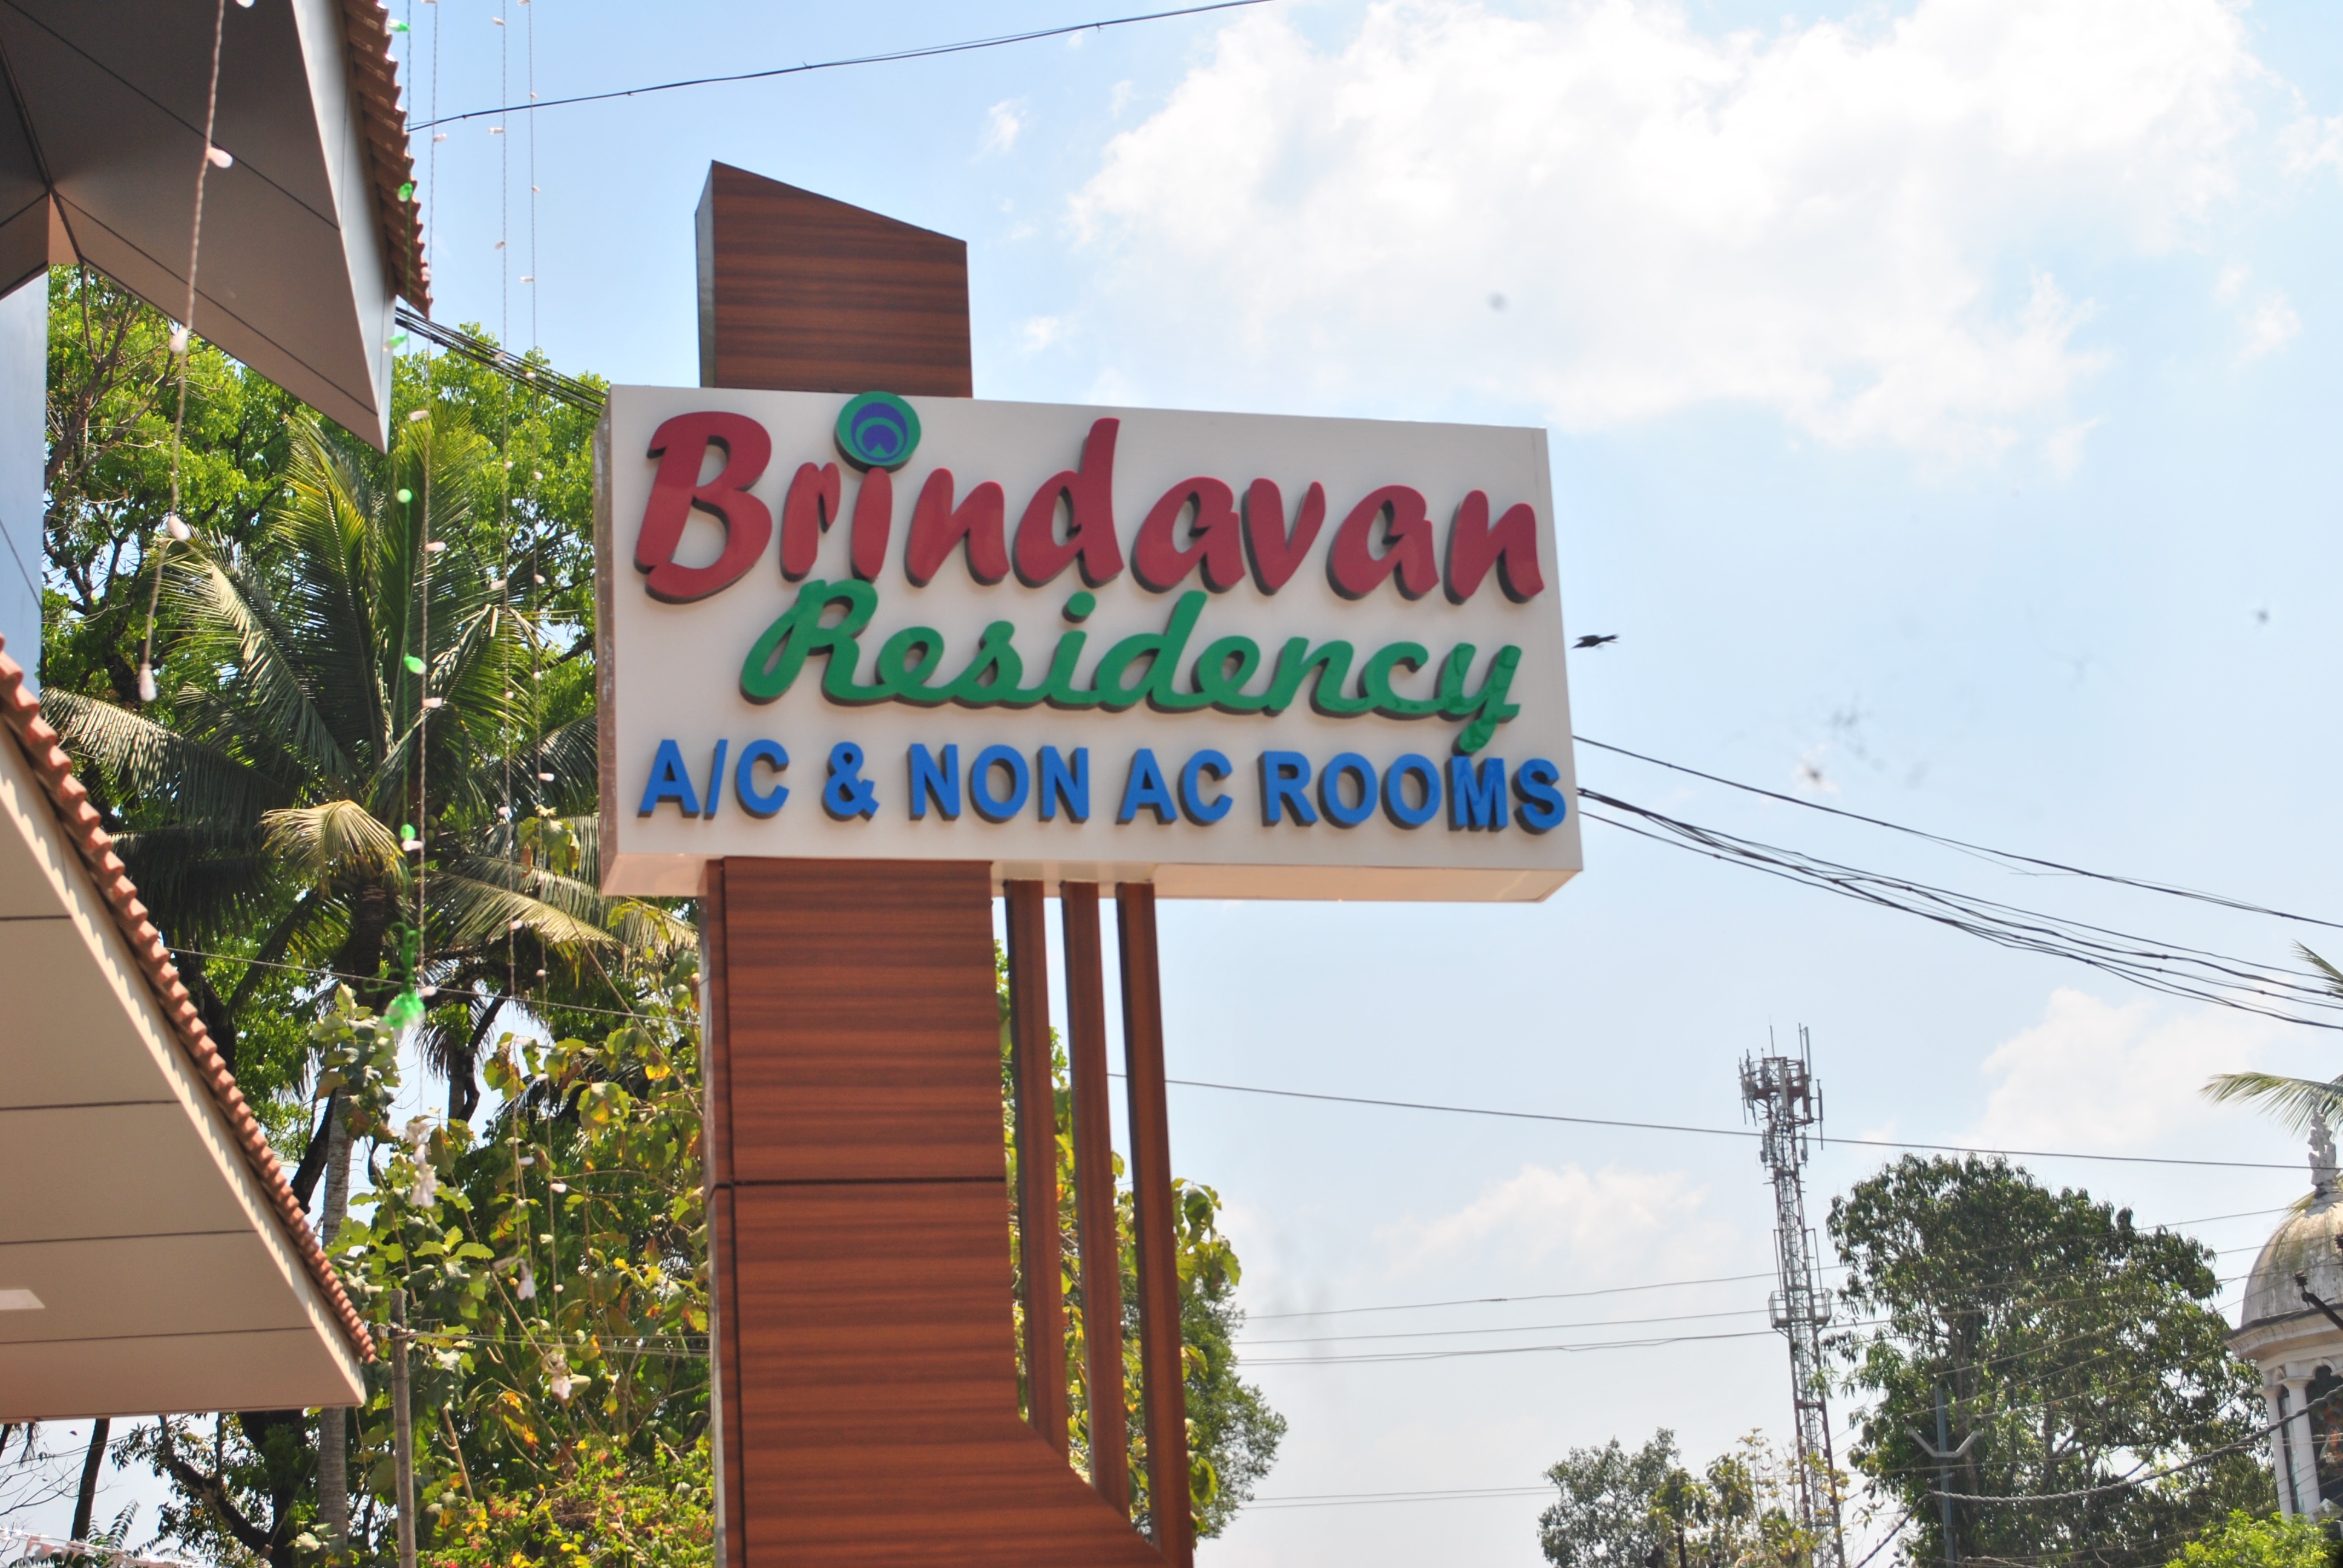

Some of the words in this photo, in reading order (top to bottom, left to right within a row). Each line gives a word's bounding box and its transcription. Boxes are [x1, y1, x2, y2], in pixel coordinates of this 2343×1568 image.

[635, 391, 1545, 604] Brindavan
[739, 578, 1522, 754] Residency
[638, 739, 790, 820] A/C
[822, 741, 880, 822] &
[909, 743, 1090, 825] NON
[1116, 748, 1234, 826] AC
[1260, 750, 1566, 835] ROOMS
